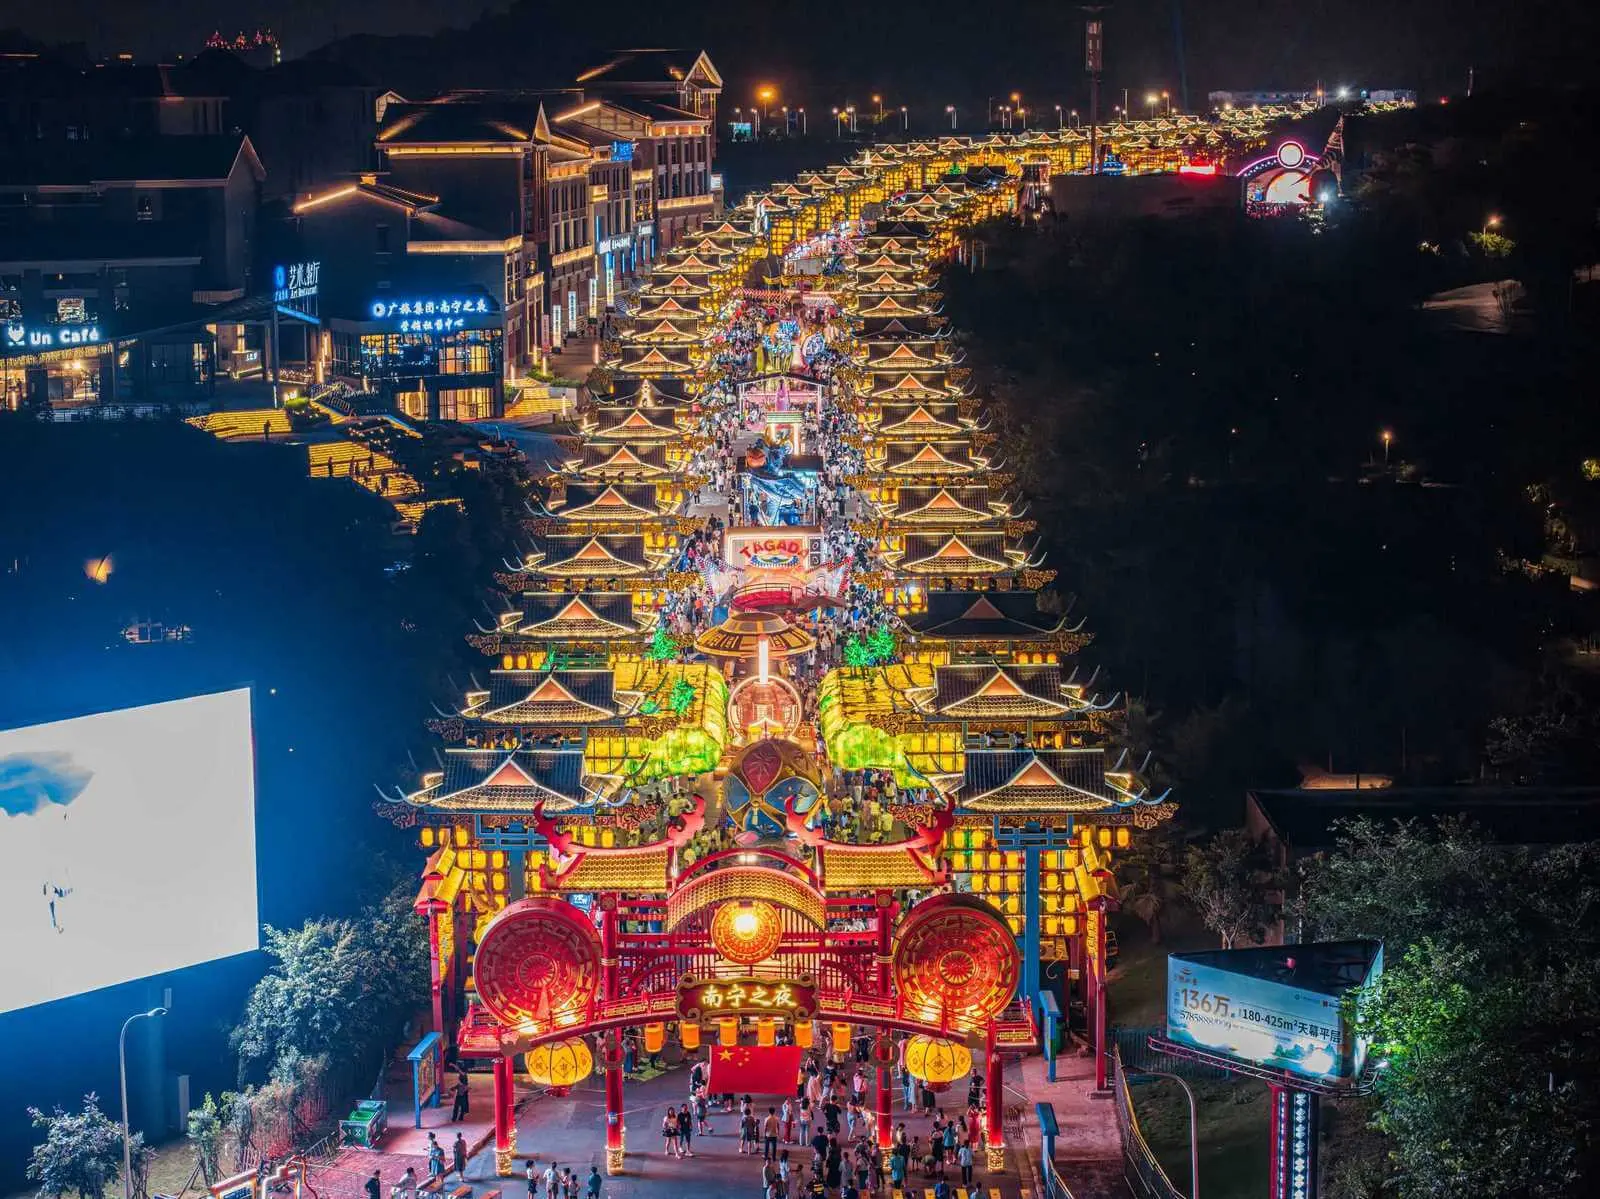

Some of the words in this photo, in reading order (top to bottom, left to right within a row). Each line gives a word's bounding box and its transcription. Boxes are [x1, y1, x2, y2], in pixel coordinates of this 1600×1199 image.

[30, 331, 52, 345] Un
[60, 327, 99, 343] Café
[702, 983, 798, 1008] 南宁之夜
[1181, 988, 1231, 1018] 136万
